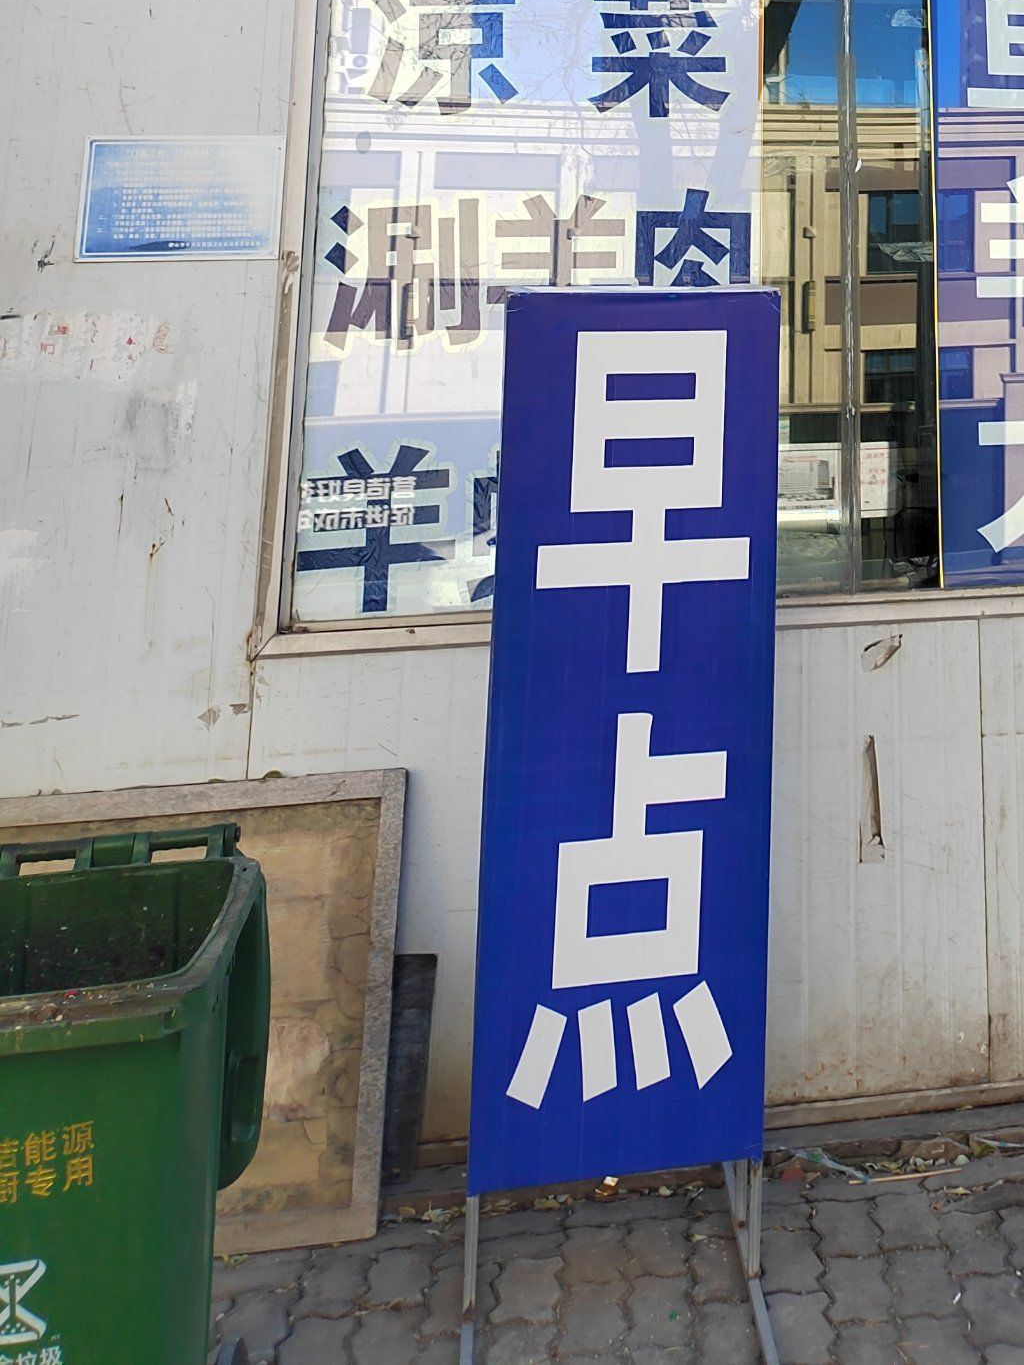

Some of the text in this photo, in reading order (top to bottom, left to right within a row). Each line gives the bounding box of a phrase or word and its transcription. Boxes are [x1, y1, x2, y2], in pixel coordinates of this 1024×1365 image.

[322, 188, 752, 350] 涮羊肉
[505, 329, 751, 1111] 早点
